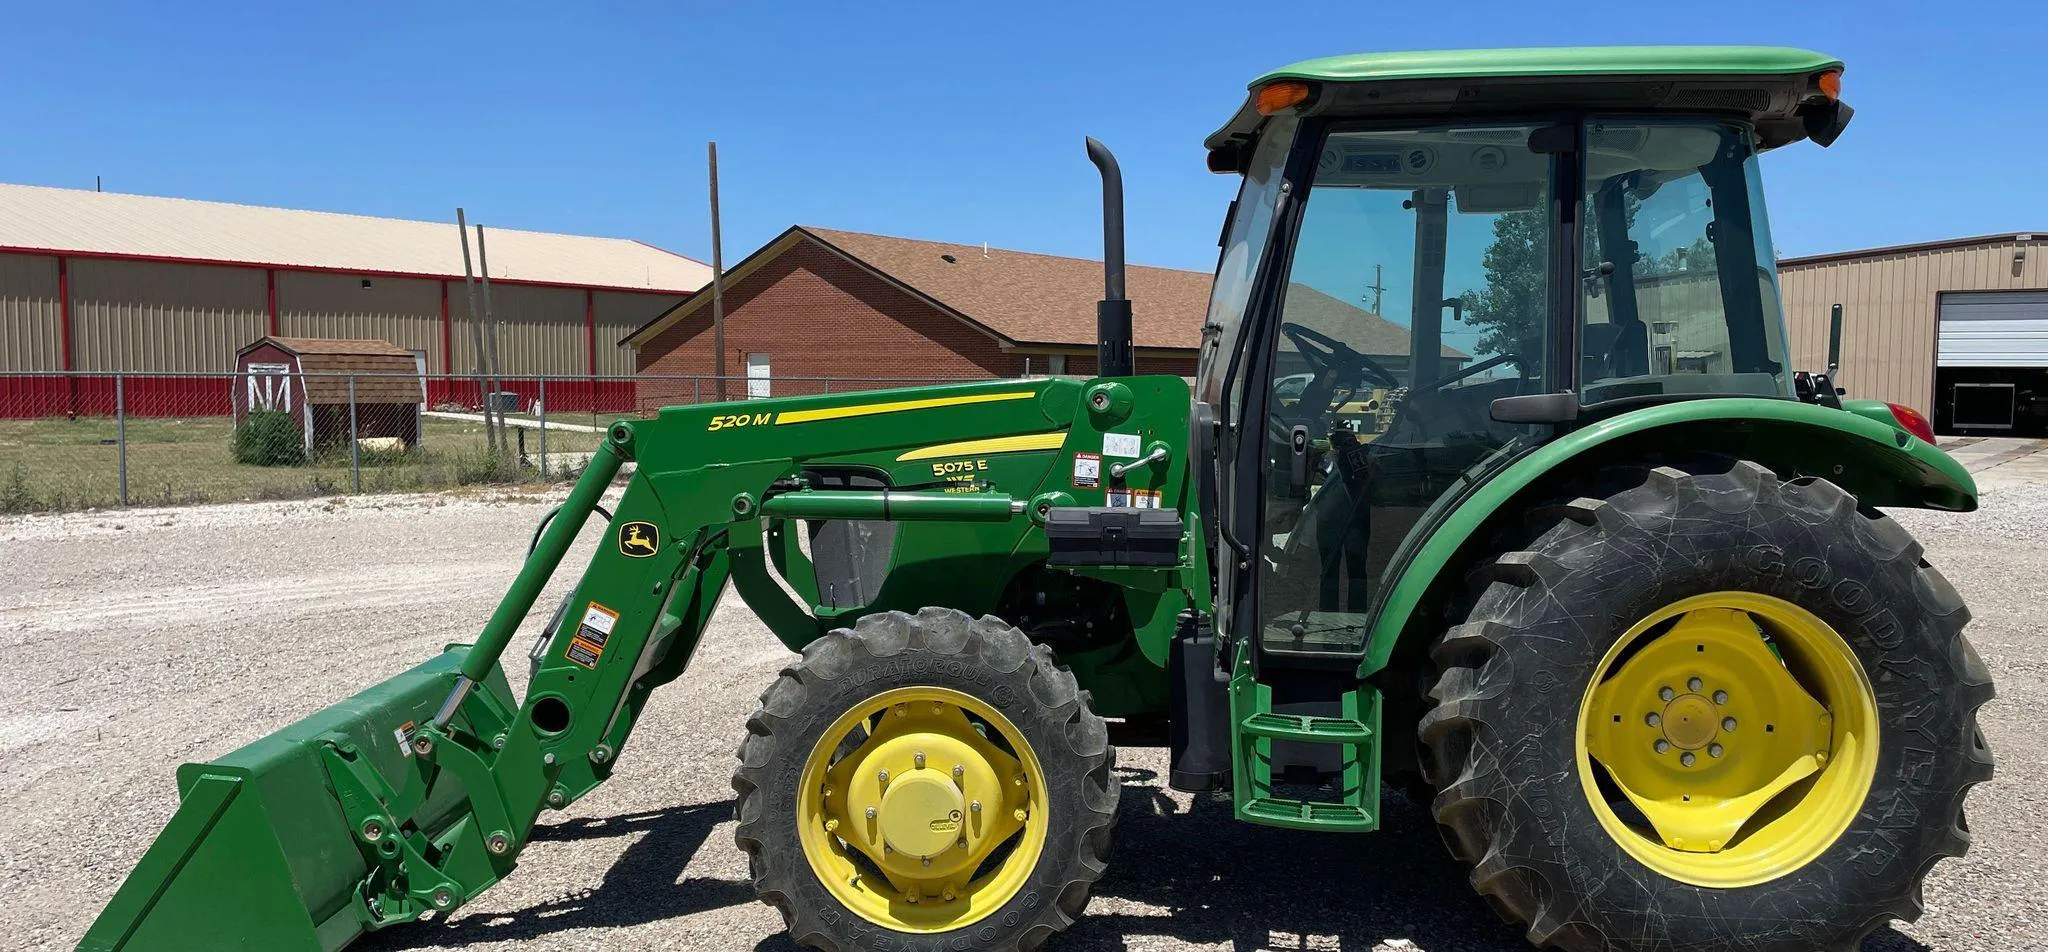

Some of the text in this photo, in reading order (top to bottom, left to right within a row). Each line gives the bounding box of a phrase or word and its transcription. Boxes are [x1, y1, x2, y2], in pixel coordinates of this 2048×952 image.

[707, 412, 772, 431] 520 M
[932, 460, 988, 476] 5075 E
[944, 485, 980, 493] WESTERN
[1746, 543, 1939, 877] GOODYEAR
[818, 891, 1040, 952] GOODYEAR
